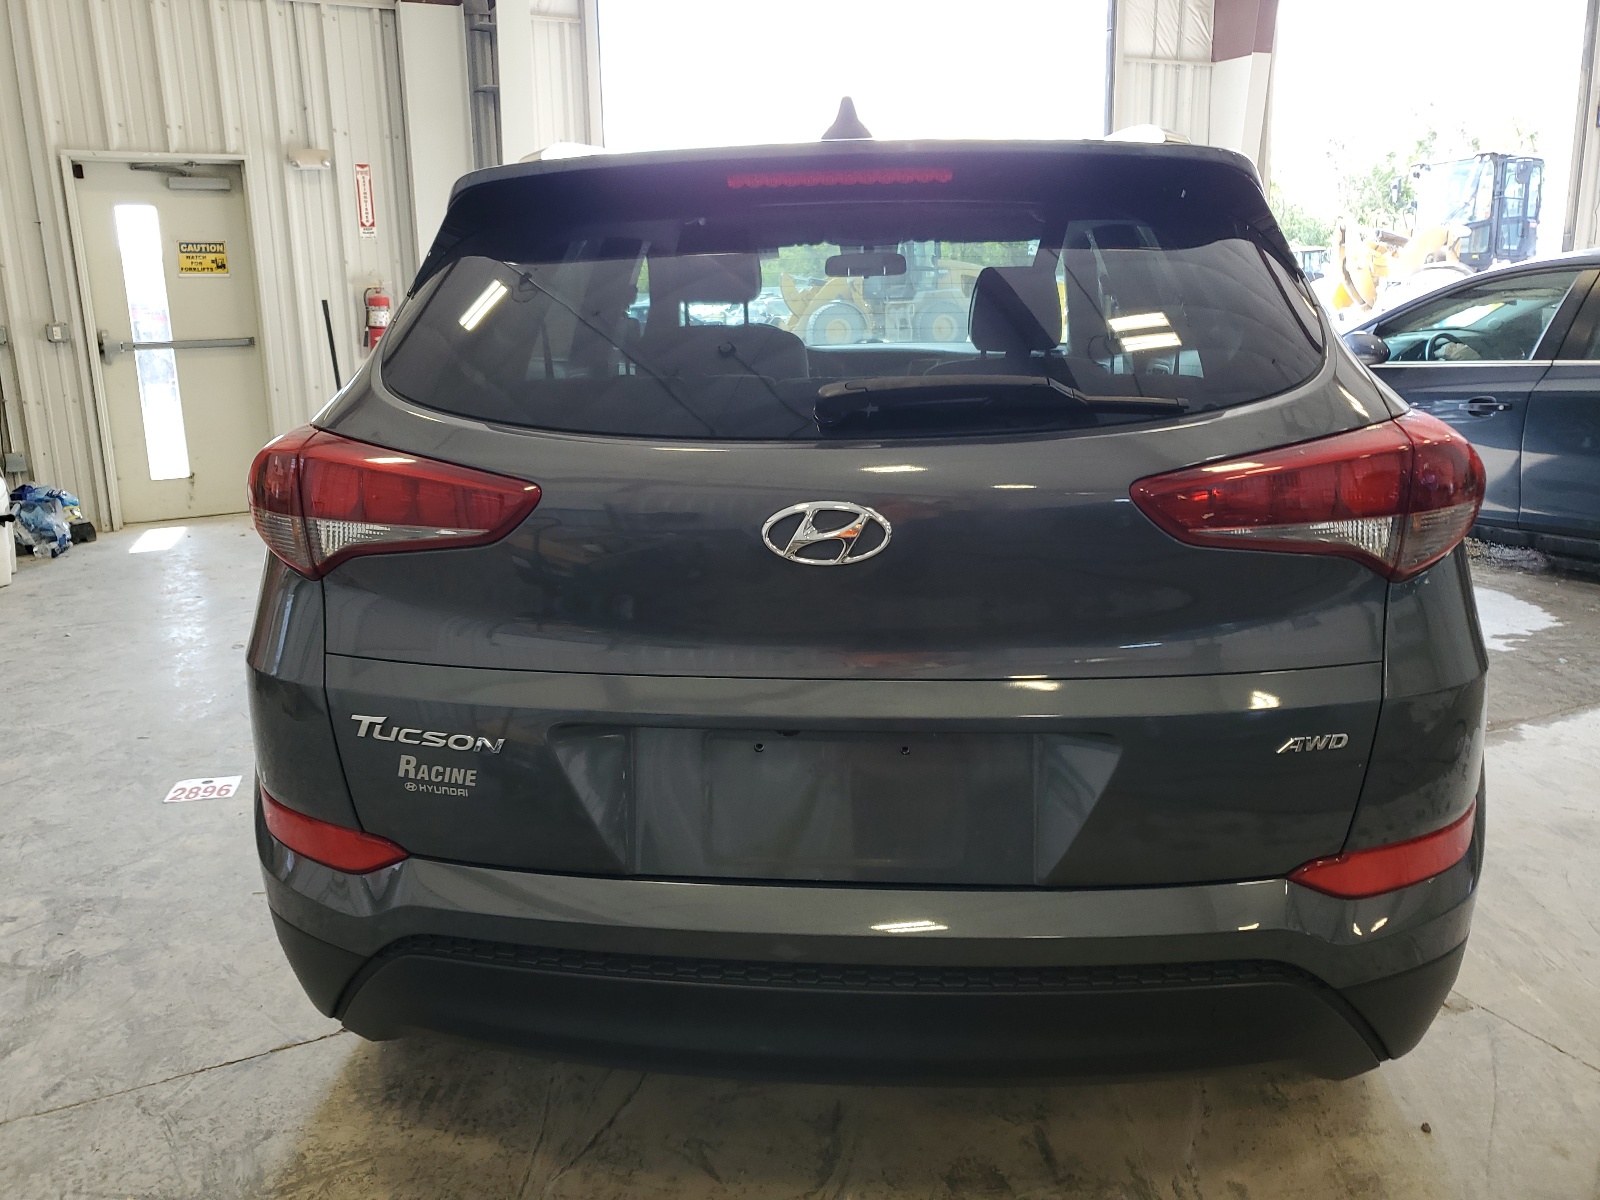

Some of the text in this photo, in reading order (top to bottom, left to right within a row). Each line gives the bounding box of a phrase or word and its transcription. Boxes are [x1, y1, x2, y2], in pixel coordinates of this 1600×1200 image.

[180, 243, 224, 253] CAUTION
[351, 714, 505, 754] TUCSON
[1276, 733, 1349, 754] AWD
[398, 754, 477, 786] RACINE
[168, 784, 233, 801] 2896
[419, 783, 469, 797] HYUNDAI
